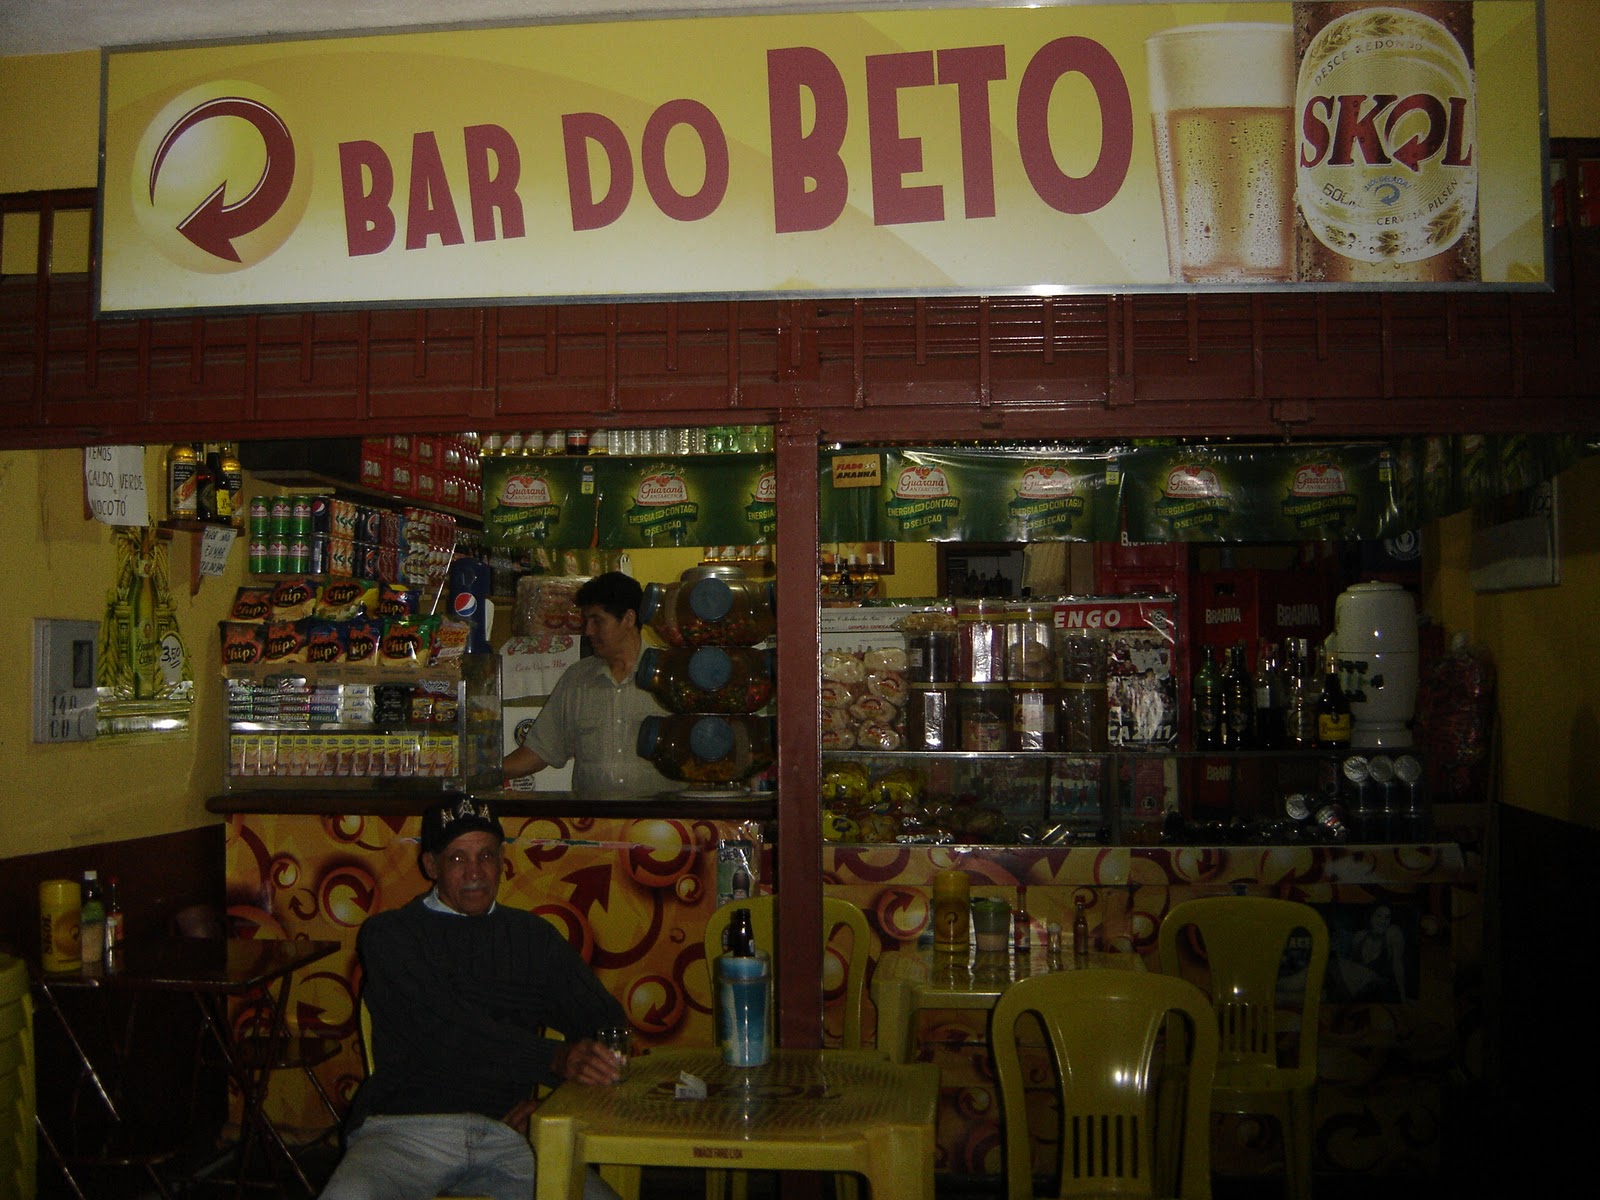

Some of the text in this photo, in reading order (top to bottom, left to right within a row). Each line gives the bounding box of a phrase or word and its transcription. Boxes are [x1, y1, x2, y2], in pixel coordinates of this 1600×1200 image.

[1314, 51, 1349, 87] DESCE
[1300, 93, 1473, 172] SKOL
[339, 36, 1134, 257] BAR DO BETO
[1428, 179, 1459, 212] PILSEN
[87, 469, 144, 491] CALDO VERDE
[900, 475, 945, 491] Guaraná
[506, 483, 547, 499] Guaraná
[641, 483, 683, 499] Guaraná
[629, 512, 655, 524] ENERGIA
[888, 505, 915, 517] ENERGIA
[1205, 607, 1241, 625] BRAHMA
[1276, 603, 1321, 627] BRAHMA
[161, 645, 181, 662] 3,50
